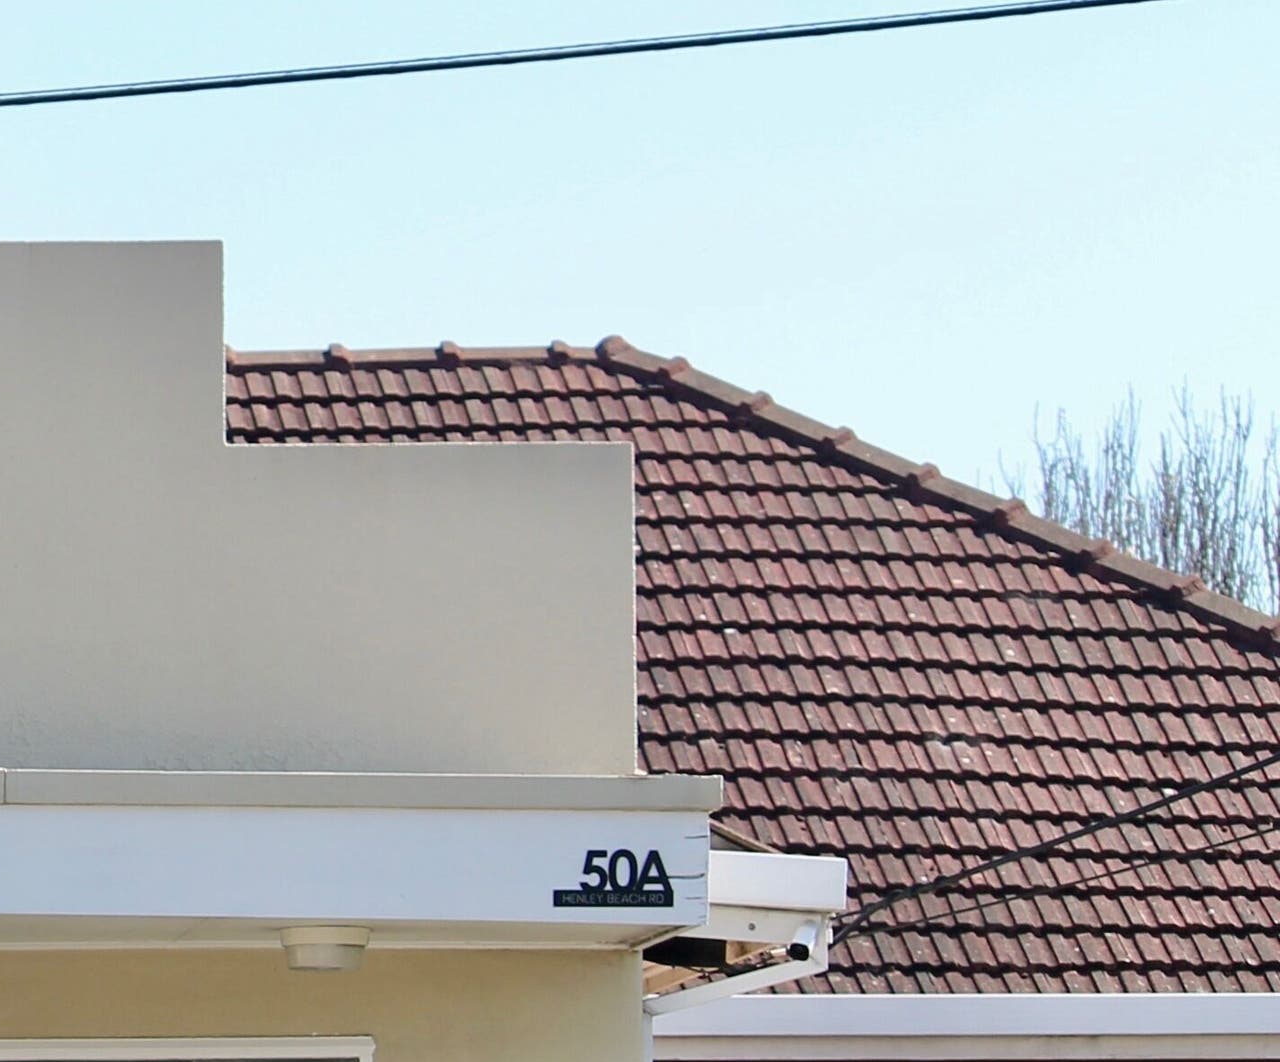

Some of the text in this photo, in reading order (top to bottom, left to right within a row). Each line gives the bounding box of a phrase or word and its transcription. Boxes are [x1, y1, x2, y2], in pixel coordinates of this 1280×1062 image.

[579, 848, 673, 891] 50A
[562, 893, 665, 904] HENLEY BEACH RD
